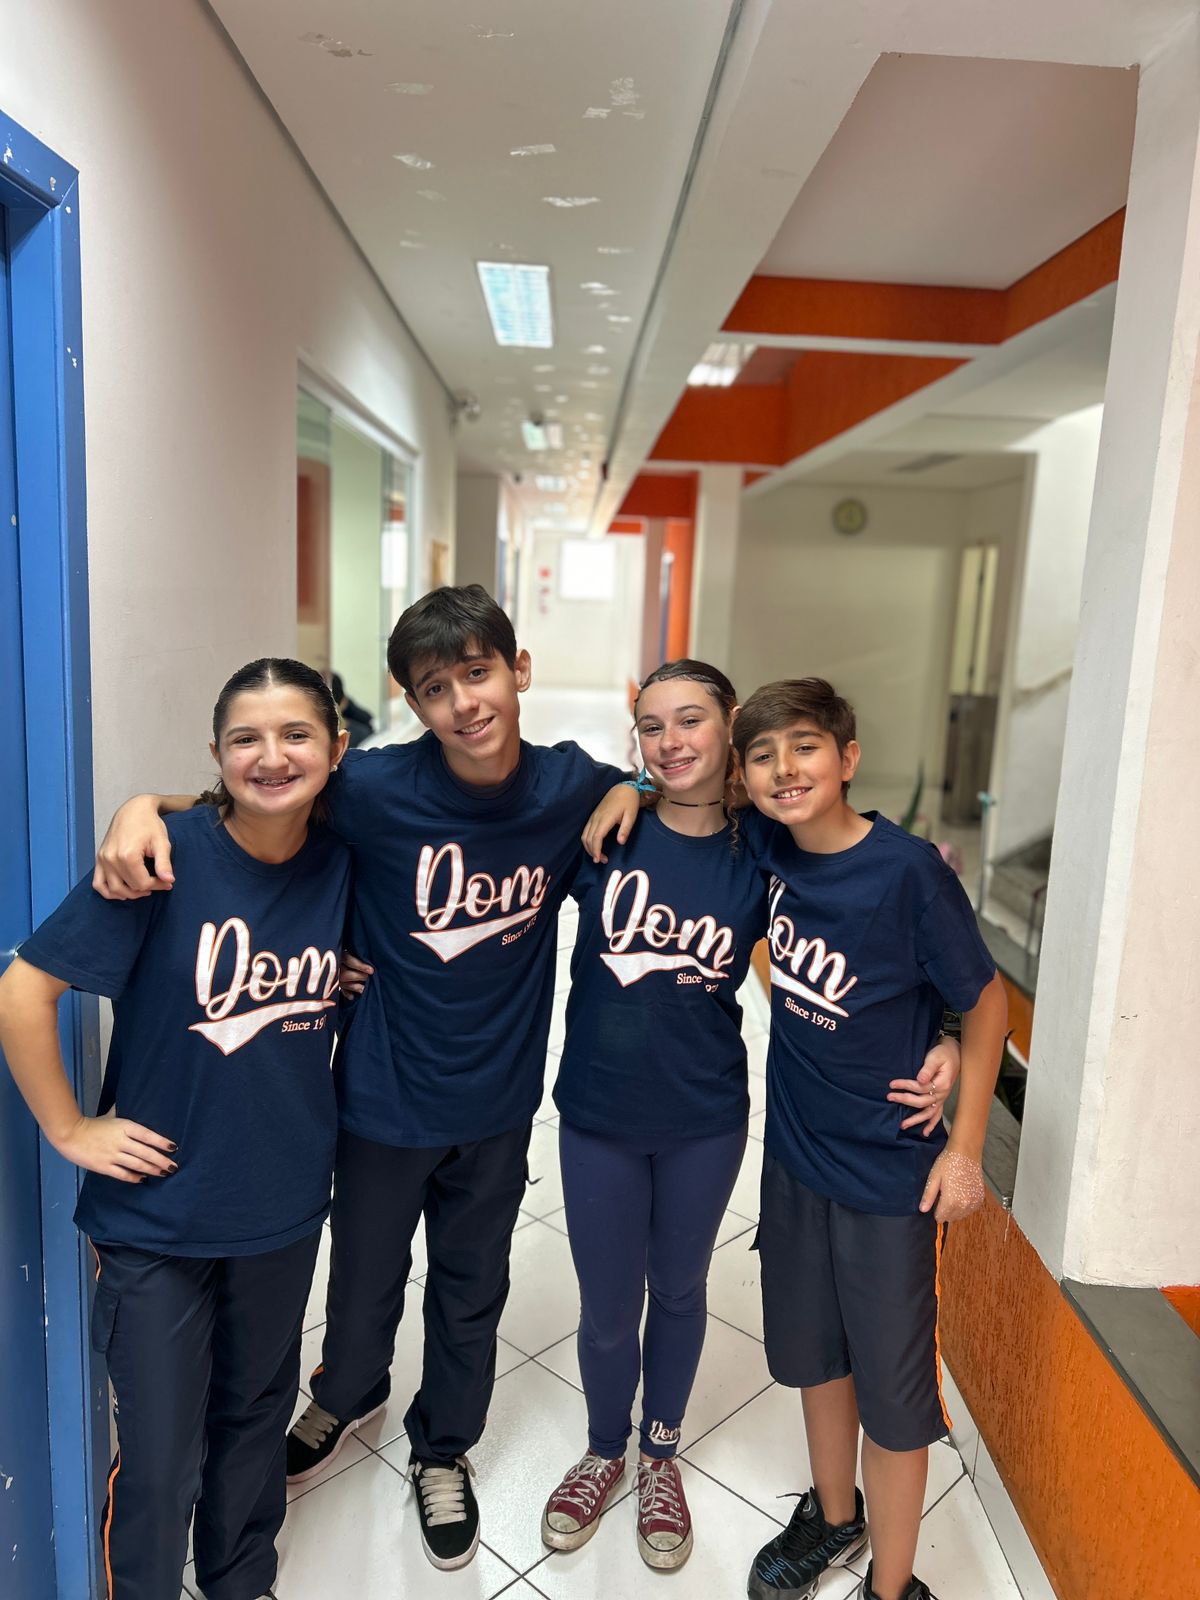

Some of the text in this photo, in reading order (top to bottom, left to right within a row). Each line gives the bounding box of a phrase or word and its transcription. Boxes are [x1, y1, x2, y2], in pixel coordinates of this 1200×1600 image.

[416, 842, 550, 930] Dom
[602, 869, 736, 970] Dom
[195, 917, 339, 1020] Dom
[676, 972, 703, 985] Since
[281, 1020, 311, 1033] Since
[784, 996, 837, 1031] Since 1973
